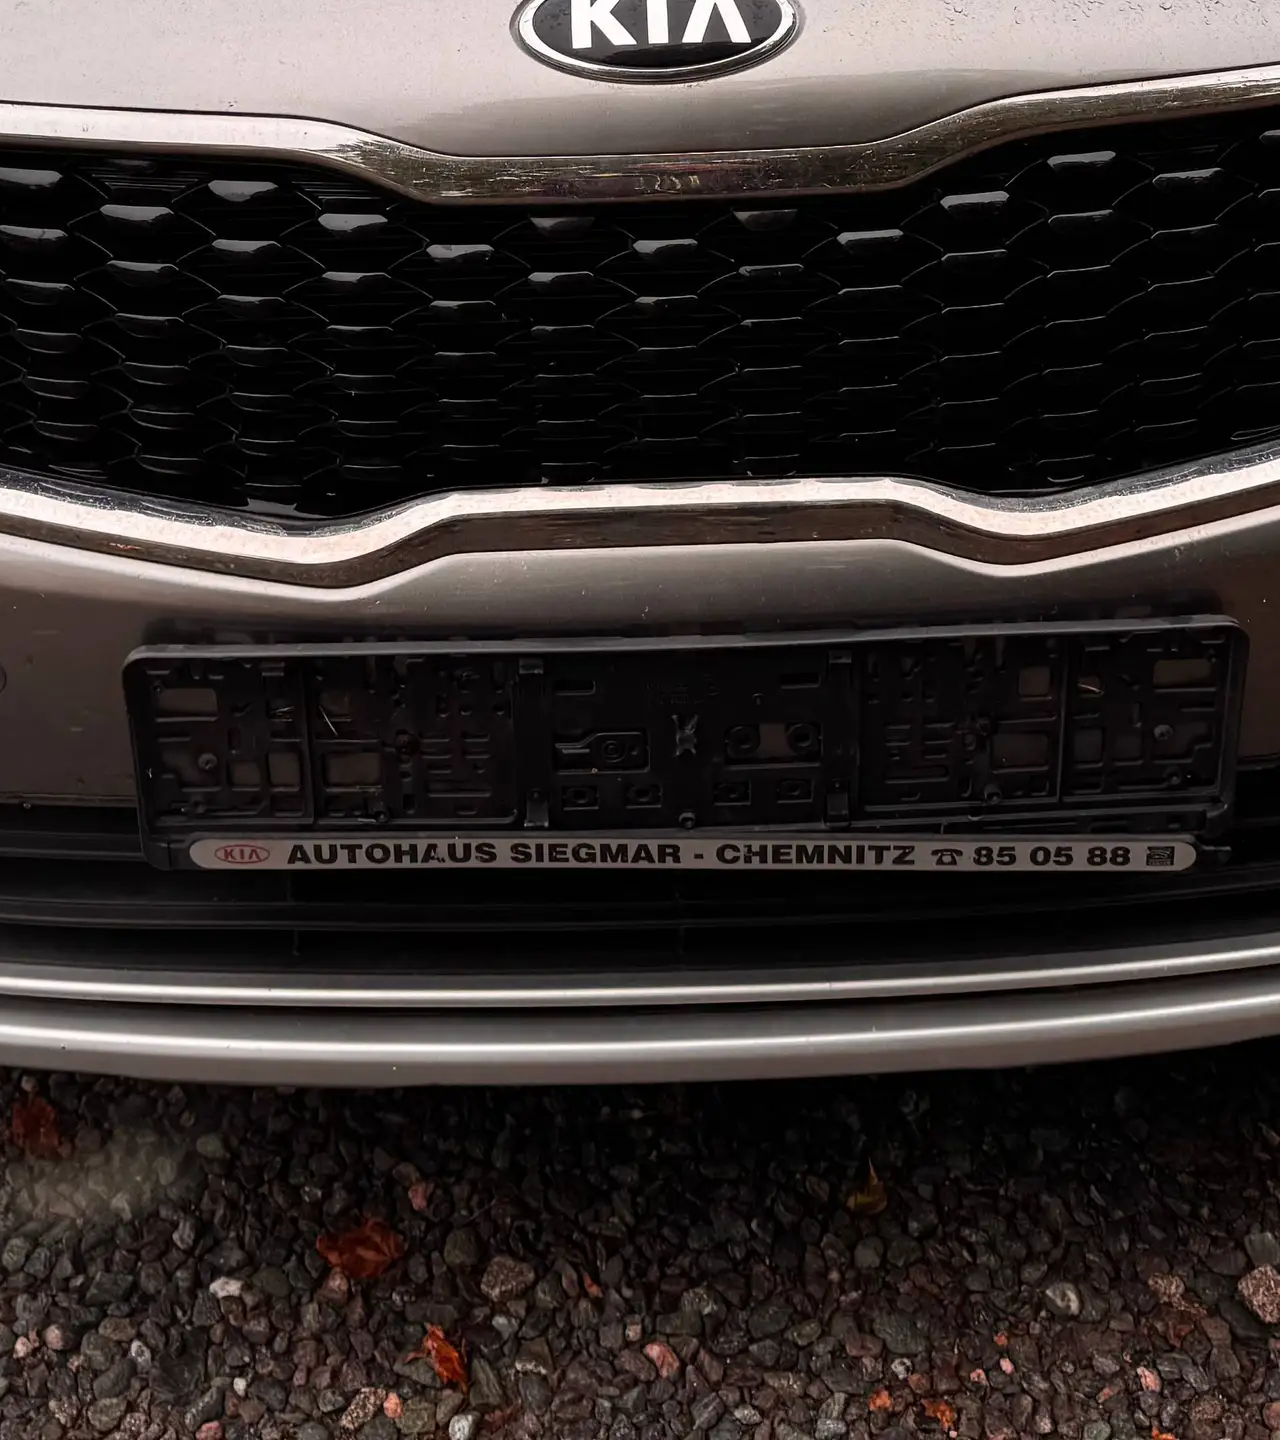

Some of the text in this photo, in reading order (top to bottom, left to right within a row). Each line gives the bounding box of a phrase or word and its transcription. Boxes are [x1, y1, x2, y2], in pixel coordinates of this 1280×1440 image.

[223, 847, 263, 861] KIA
[287, 842, 498, 865] AUTOHAUS
[510, 842, 682, 864] SIEGMAR
[716, 843, 916, 865] CHEMNITZ
[972, 846, 1017, 866] 85
[1029, 846, 1074, 866] 05
[1086, 846, 1131, 866] 88
